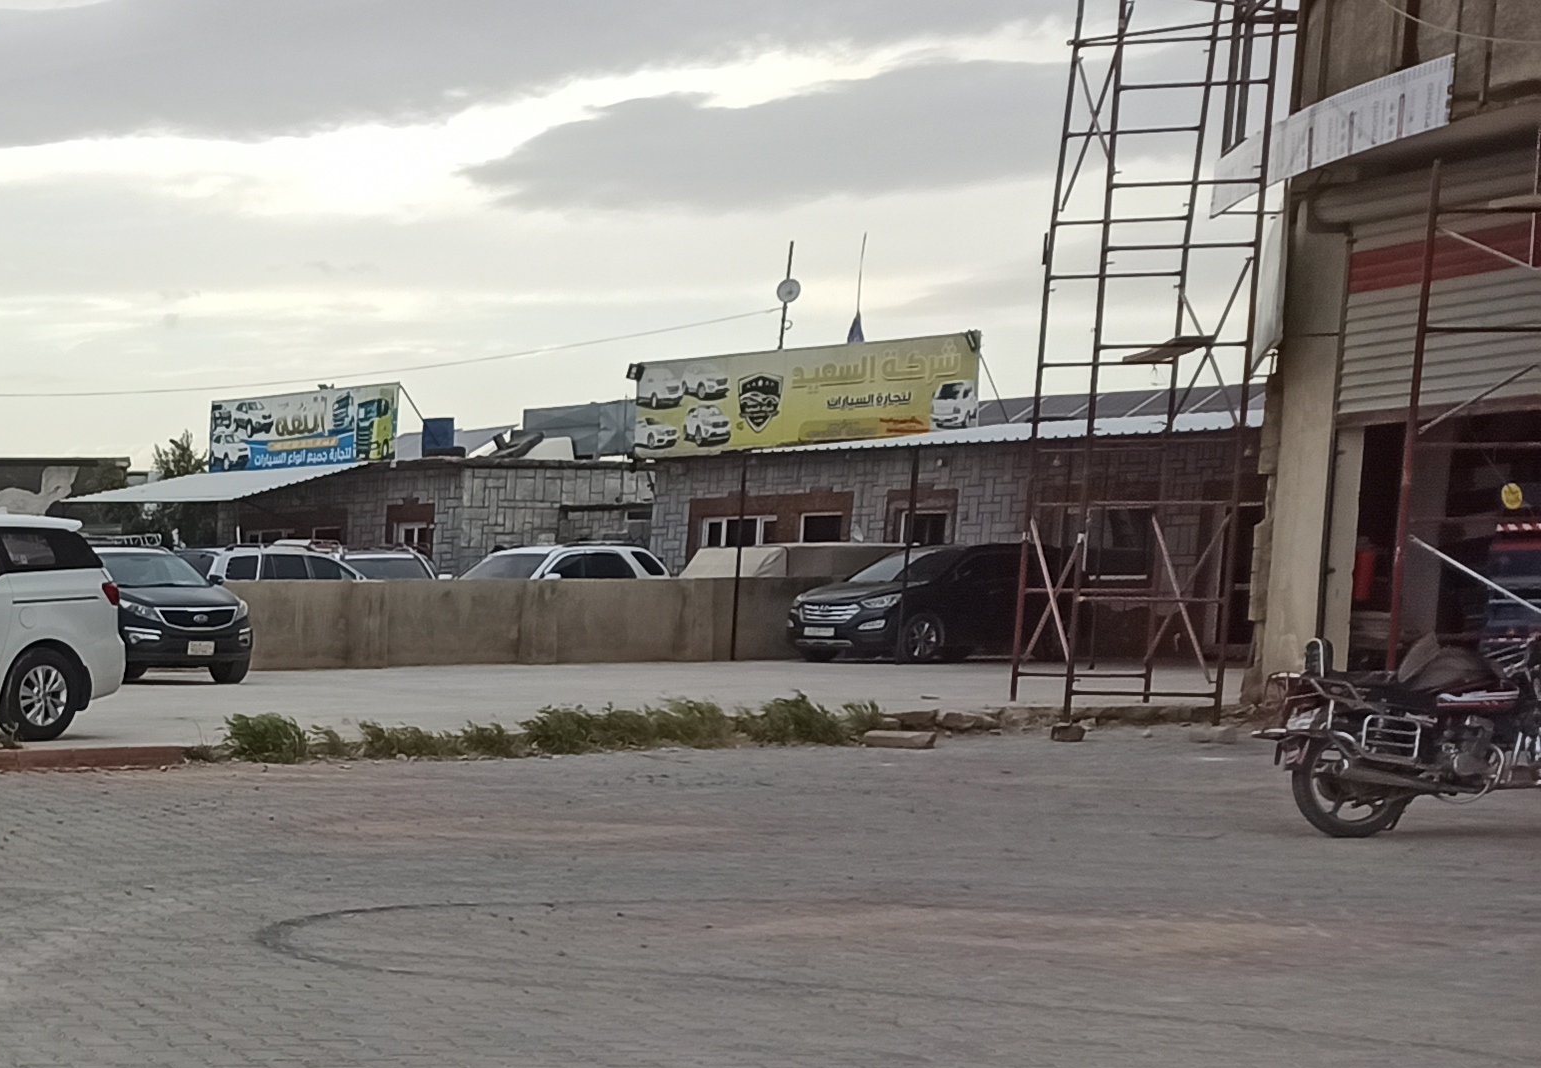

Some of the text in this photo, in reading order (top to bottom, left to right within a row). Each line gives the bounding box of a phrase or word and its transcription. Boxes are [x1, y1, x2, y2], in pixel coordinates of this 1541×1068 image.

[791, 338, 961, 394] شركة السعيد
[826, 391, 912, 410] لتجارة السيارات
[253, 452, 287, 468] السيارات
[306, 450, 328, 464] جميع
[328, 446, 352, 463] لتجارة
